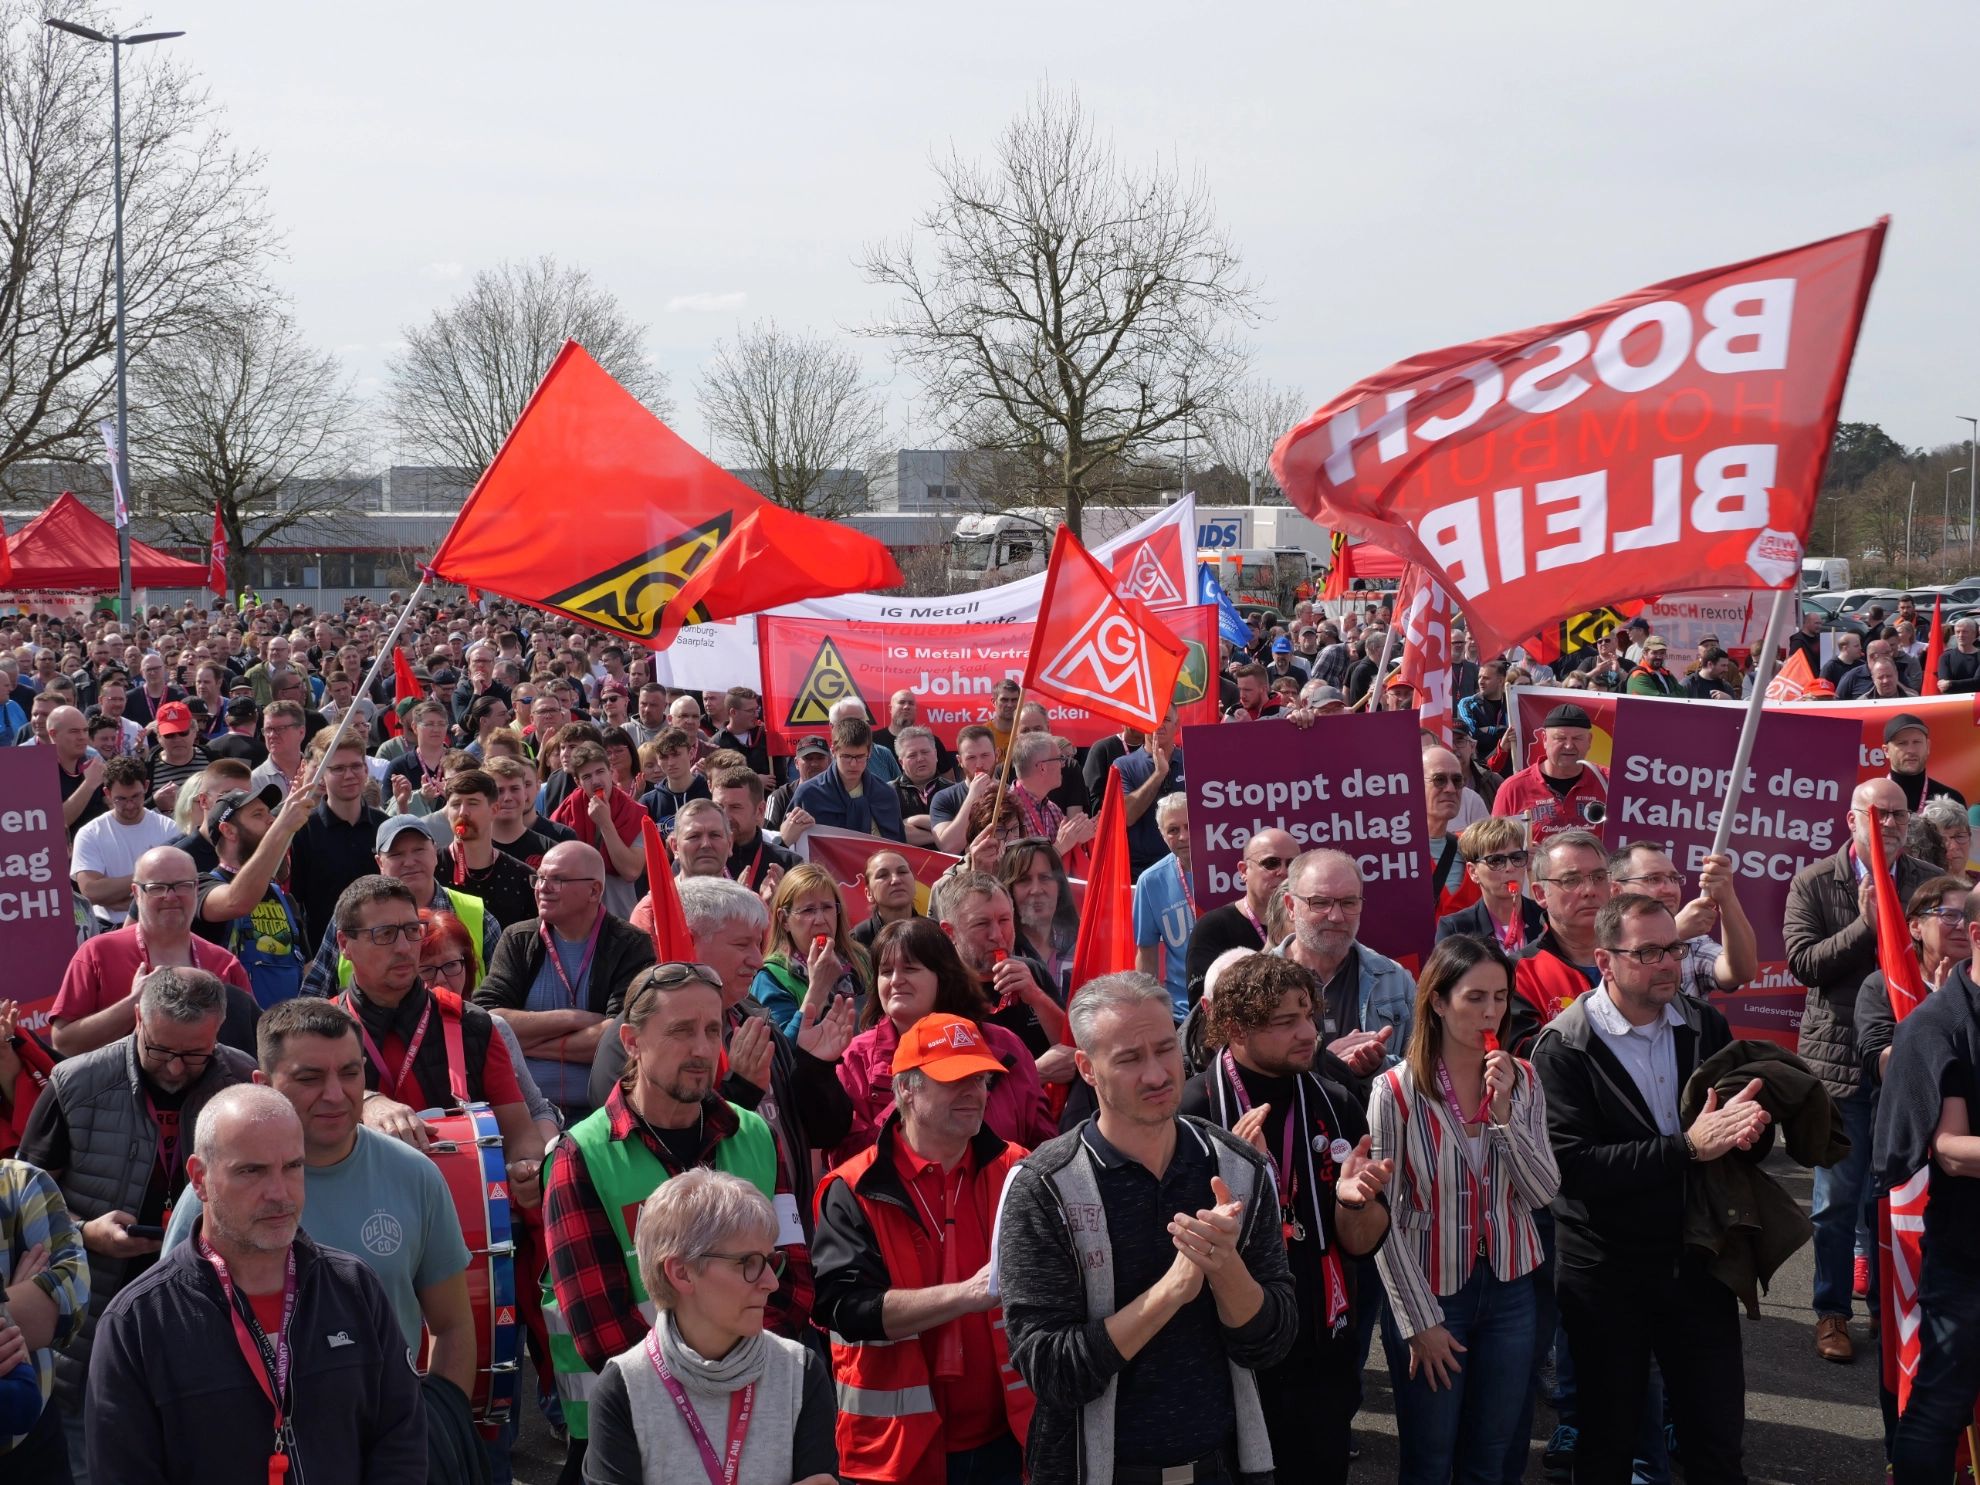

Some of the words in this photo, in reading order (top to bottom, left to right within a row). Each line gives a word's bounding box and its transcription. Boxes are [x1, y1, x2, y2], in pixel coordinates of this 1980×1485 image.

[55, 597, 76, 605] WIR
[880, 606, 903, 618] IG
[910, 601, 980, 618] Metall
[1651, 602, 1698, 618] BOSCH
[677, 636, 716, 648] Saarpfalz
[888, 647, 909, 659] IG
[915, 647, 972, 660] Metall
[910, 671, 992, 696] John
[926, 708, 972, 723] Werk
[1624, 753, 1757, 800] Stoppt
[1767, 767, 1839, 802] den
[1201, 772, 1331, 812] Stoppt
[1341, 768, 1411, 799] den
[927, 1037, 947, 1048] BOSCH
[1440, 1070, 1452, 1091] DABEI
[278, 1341, 290, 1384] ZUKUNFT
[652, 1353, 672, 1381] DABEI
[723, 1457, 737, 1483] UNFT
[730, 1439, 742, 1456] AN!
